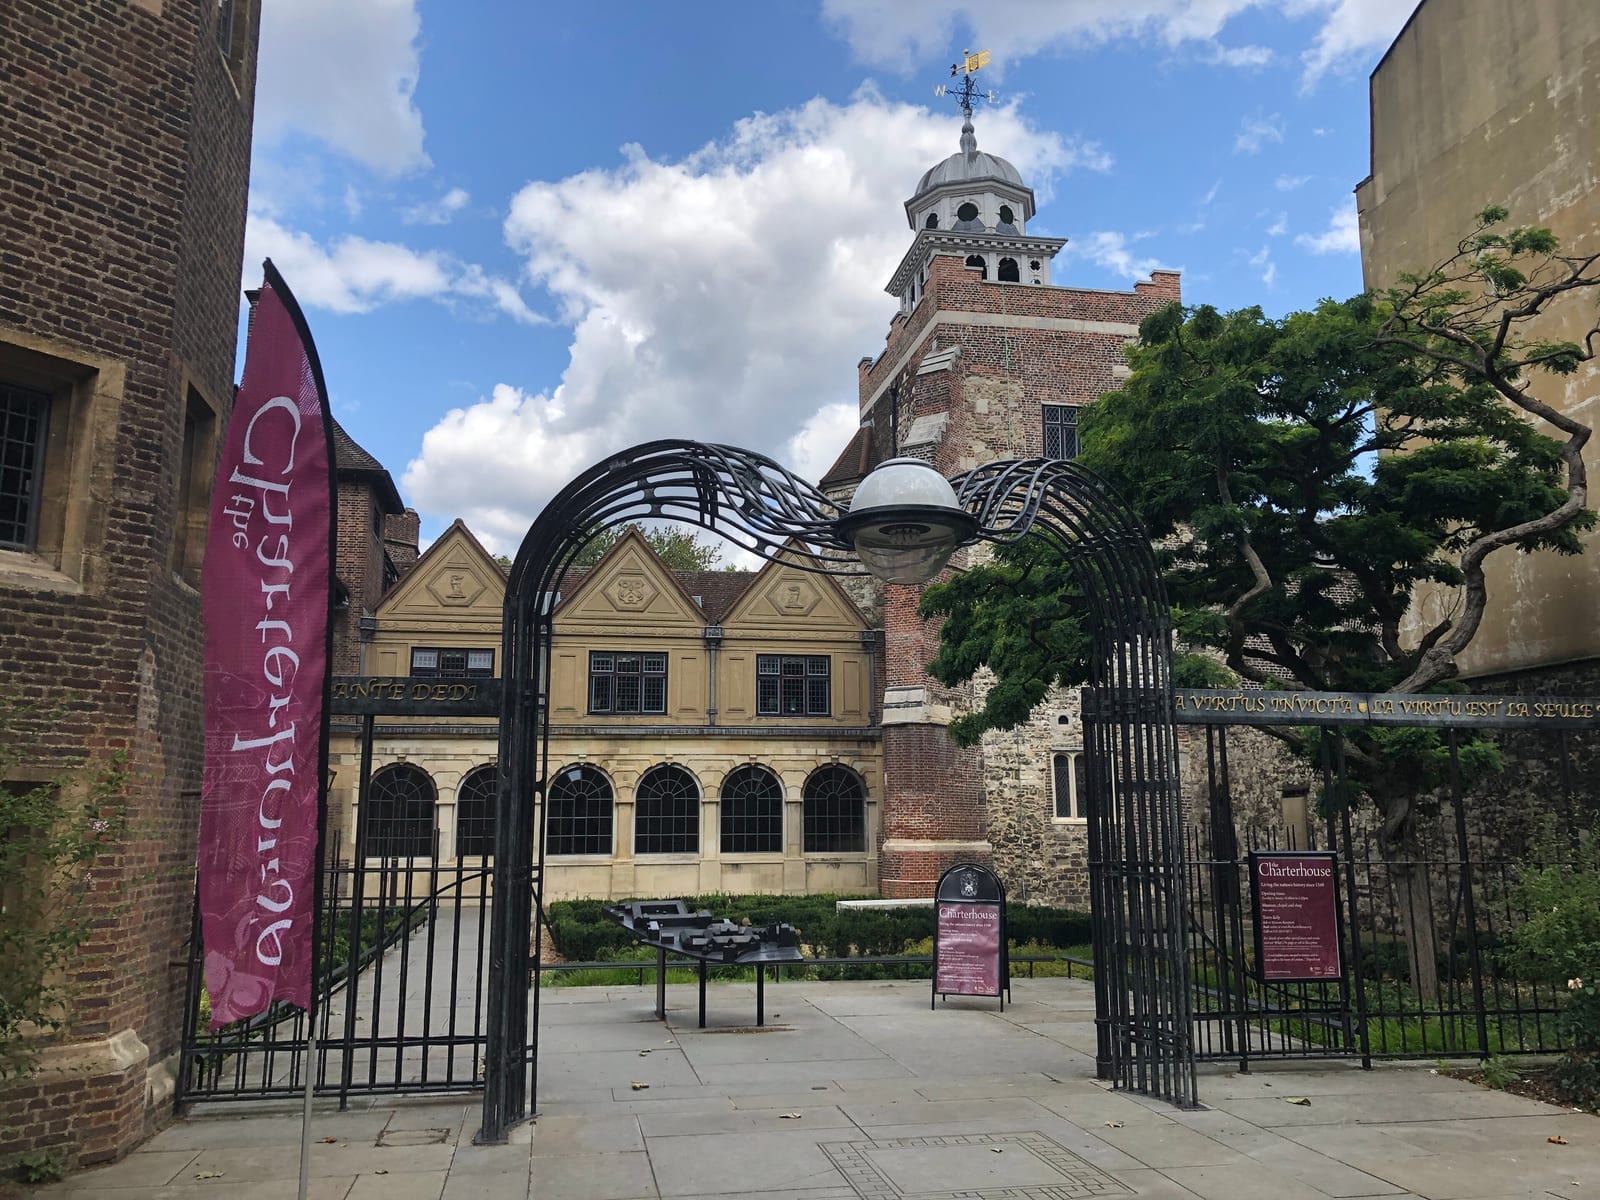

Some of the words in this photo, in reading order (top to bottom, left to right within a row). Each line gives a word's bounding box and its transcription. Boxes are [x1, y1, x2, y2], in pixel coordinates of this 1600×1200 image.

[934, 84, 946, 97] W
[332, 678, 406, 700] ANTE
[412, 683, 478, 701] DEDI
[1190, 692, 1267, 712] VIRTUS
[1271, 693, 1354, 714] INVICTA
[1371, 699, 1396, 715] LA
[1505, 701, 1531, 718] LA
[1534, 701, 1594, 719] SEULE
[1259, 862, 1331, 877] Charterhouse
[939, 907, 998, 920] Charterhouse
